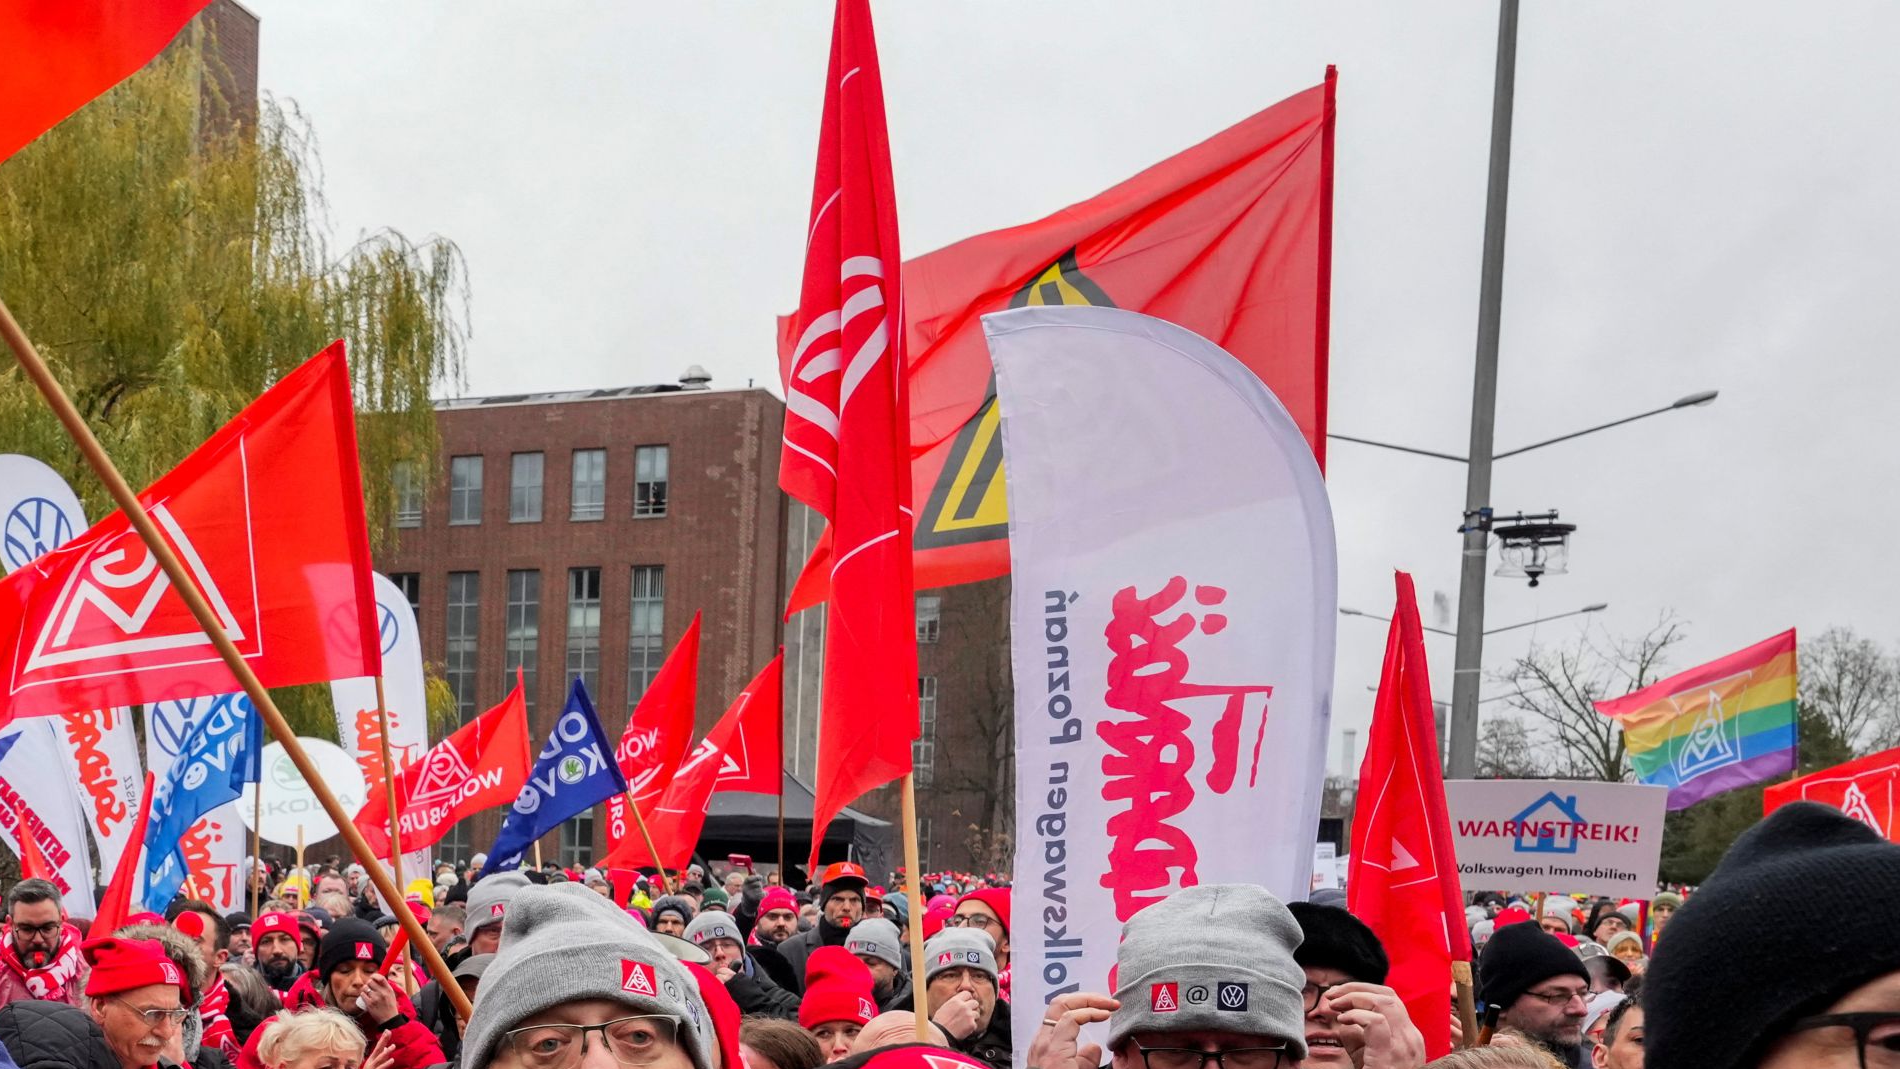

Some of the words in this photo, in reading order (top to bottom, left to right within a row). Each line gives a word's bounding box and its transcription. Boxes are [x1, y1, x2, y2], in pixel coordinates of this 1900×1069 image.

[1458, 820, 1639, 843] WARNSTREIK!
[1456, 863, 1544, 878] Volkswagen
[1549, 864, 1638, 881] Immobilien
